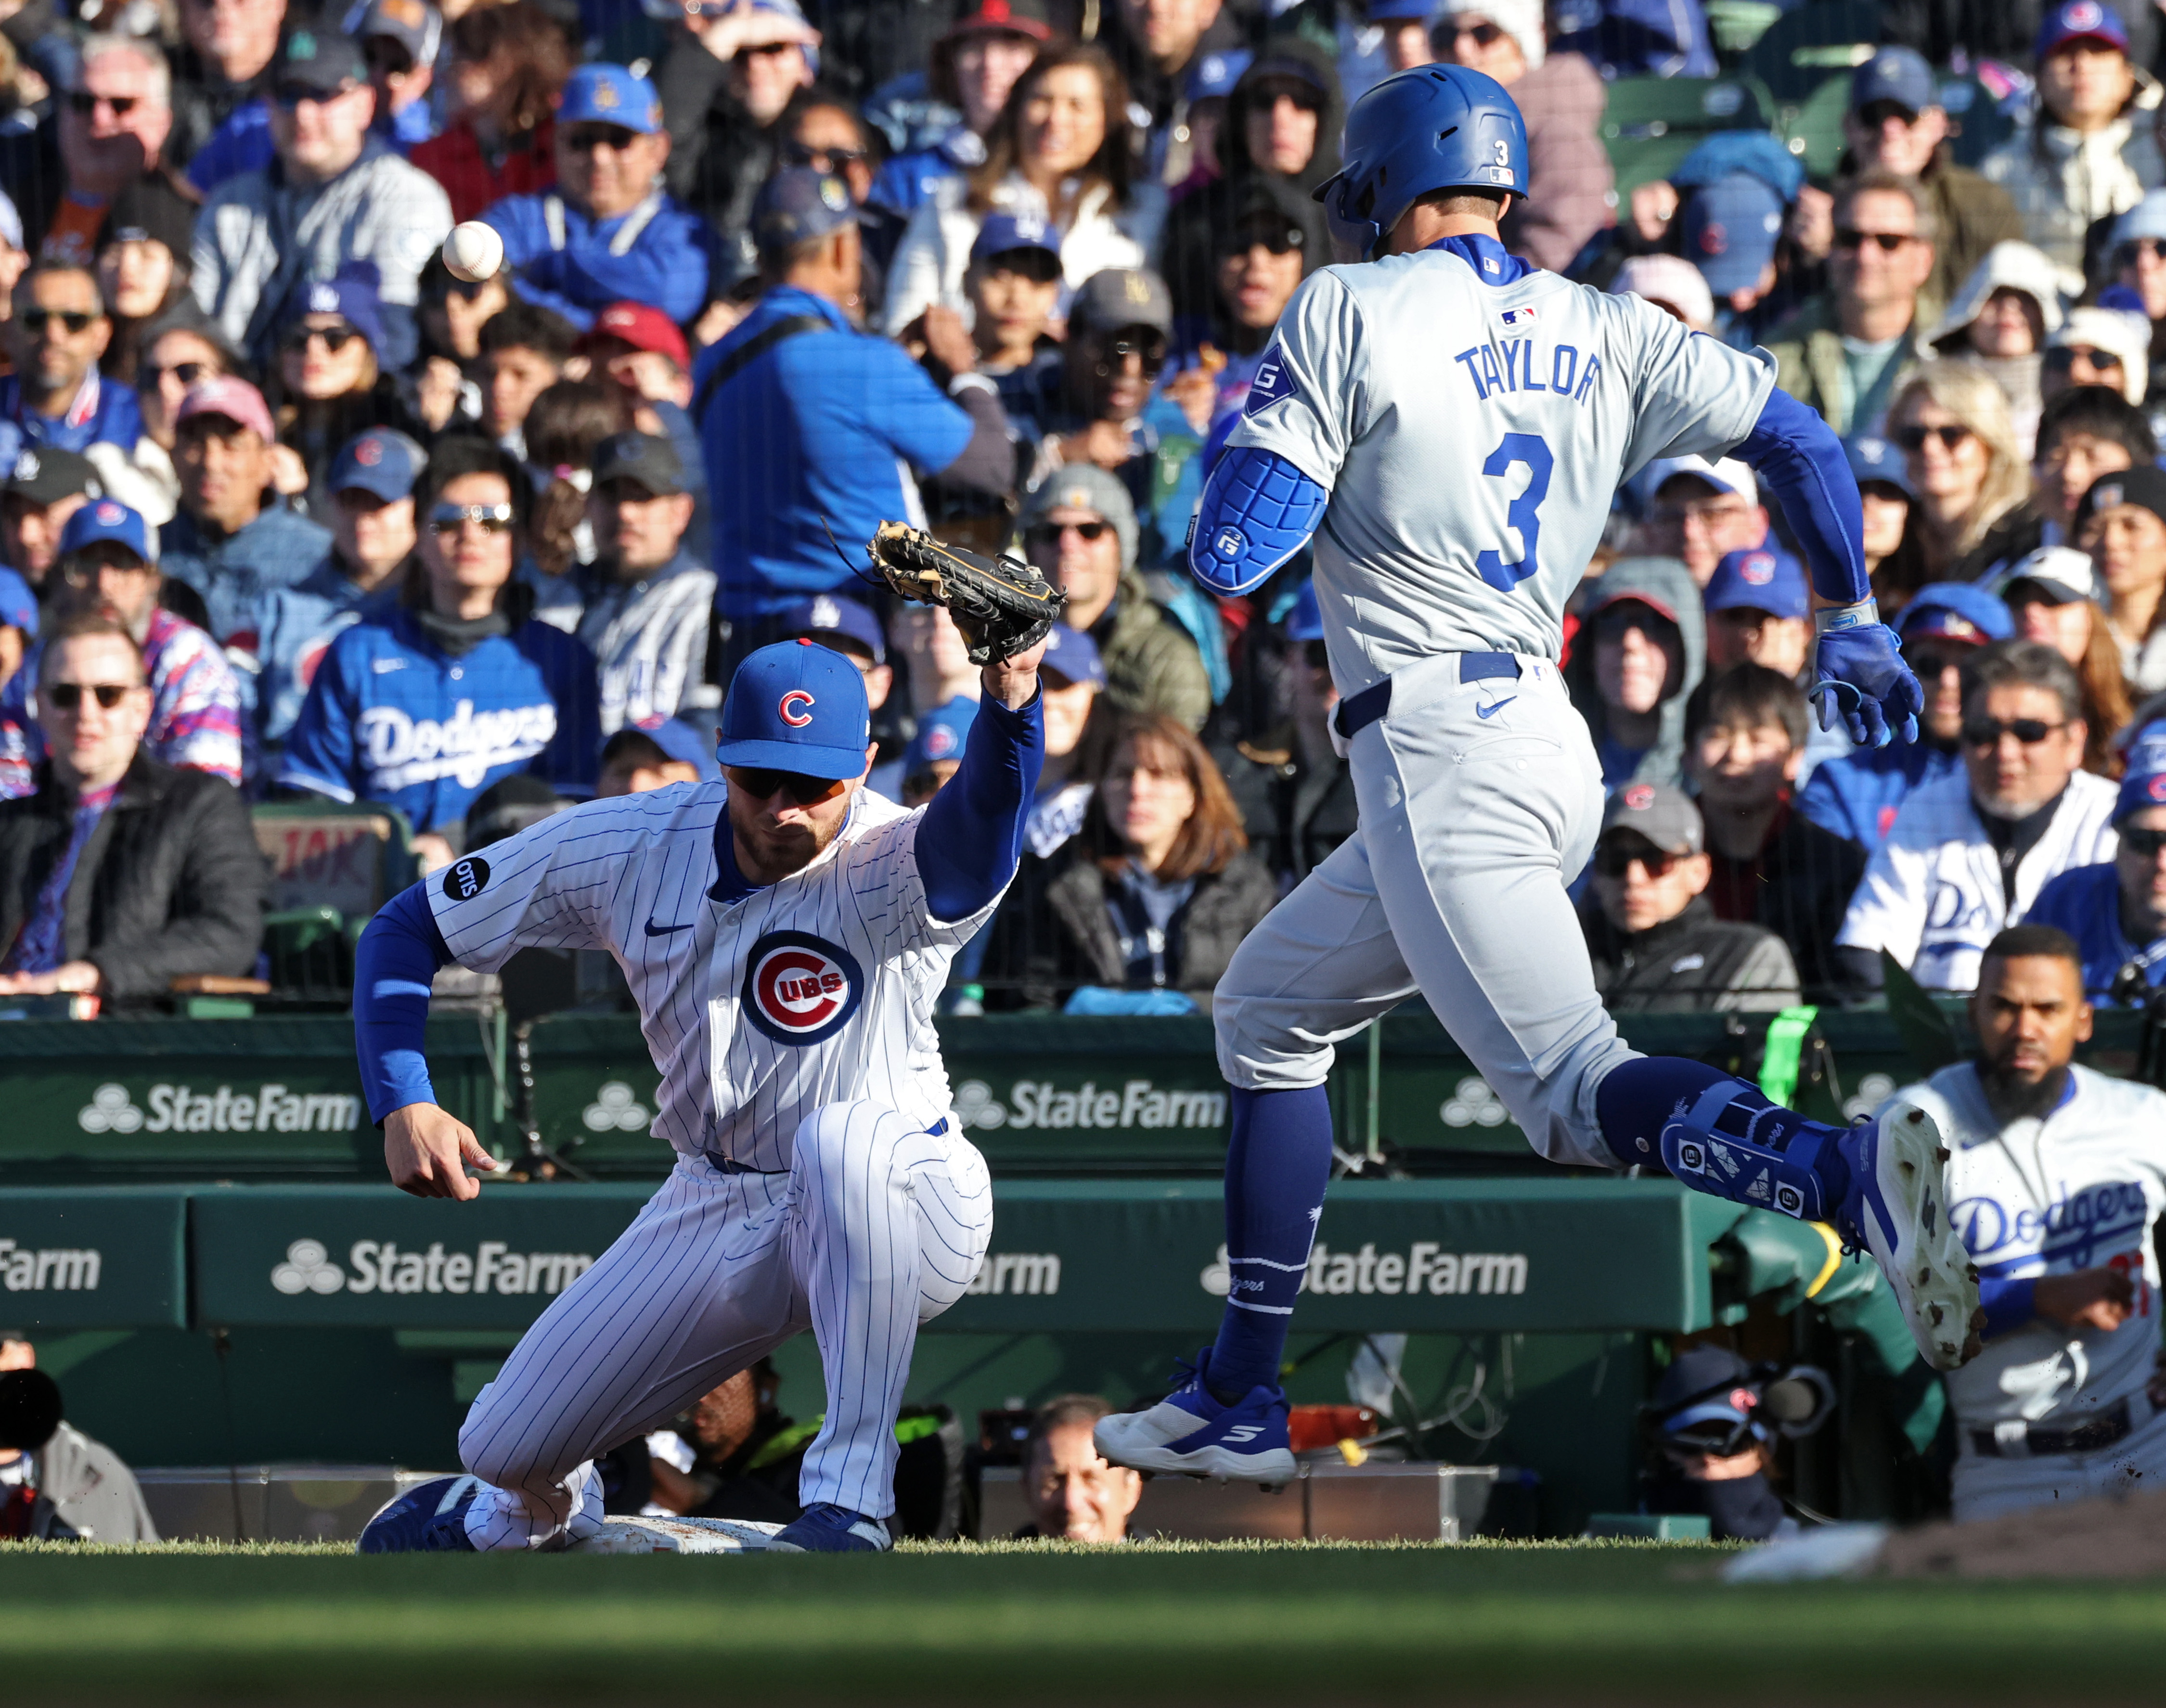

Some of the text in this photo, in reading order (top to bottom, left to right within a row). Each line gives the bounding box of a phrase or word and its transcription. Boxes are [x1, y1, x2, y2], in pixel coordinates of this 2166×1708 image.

[1494, 140, 1508, 167] 3
[1454, 339, 1600, 407] TAYLOR
[1476, 432, 1554, 592] 3
[778, 689, 816, 728] C
[456, 861, 478, 898] OTIS
